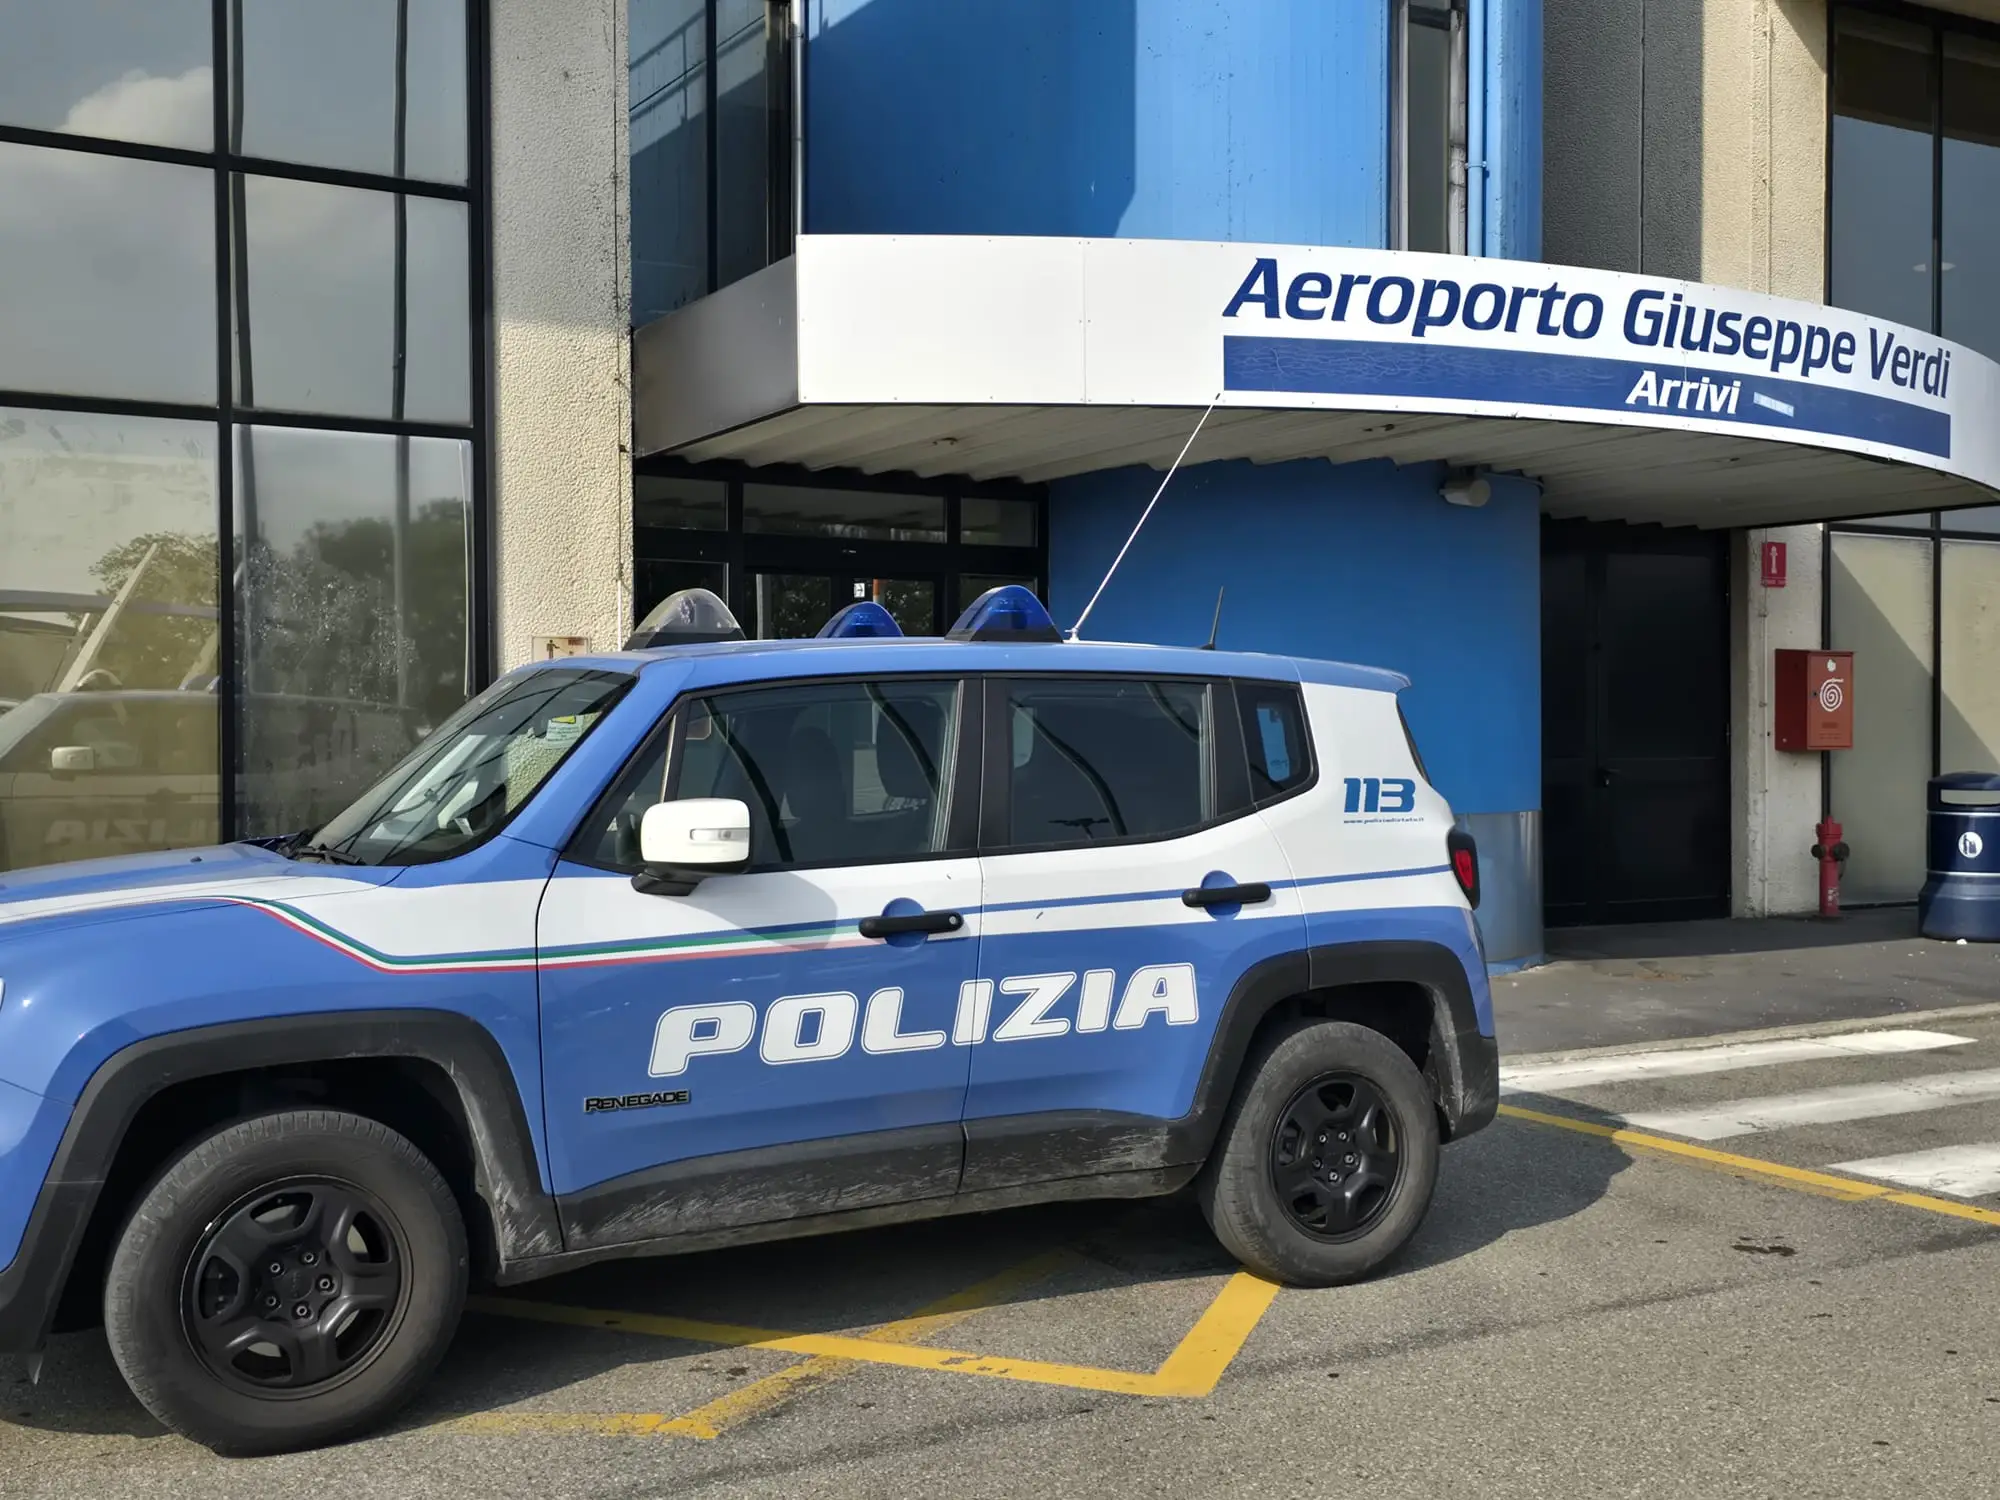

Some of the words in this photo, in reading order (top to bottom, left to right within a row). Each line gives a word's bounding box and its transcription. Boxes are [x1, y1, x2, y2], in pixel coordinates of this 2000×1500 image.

[1222, 257, 1604, 346] Aeroporto
[1623, 289, 1856, 377] Giuseppe
[1869, 328, 1950, 398] Verdi
[1626, 370, 1742, 415] Arrivi
[1343, 777, 1417, 813] 113
[648, 963, 1200, 1078] POLIZIA
[584, 1089, 690, 1113] RENEGADE
